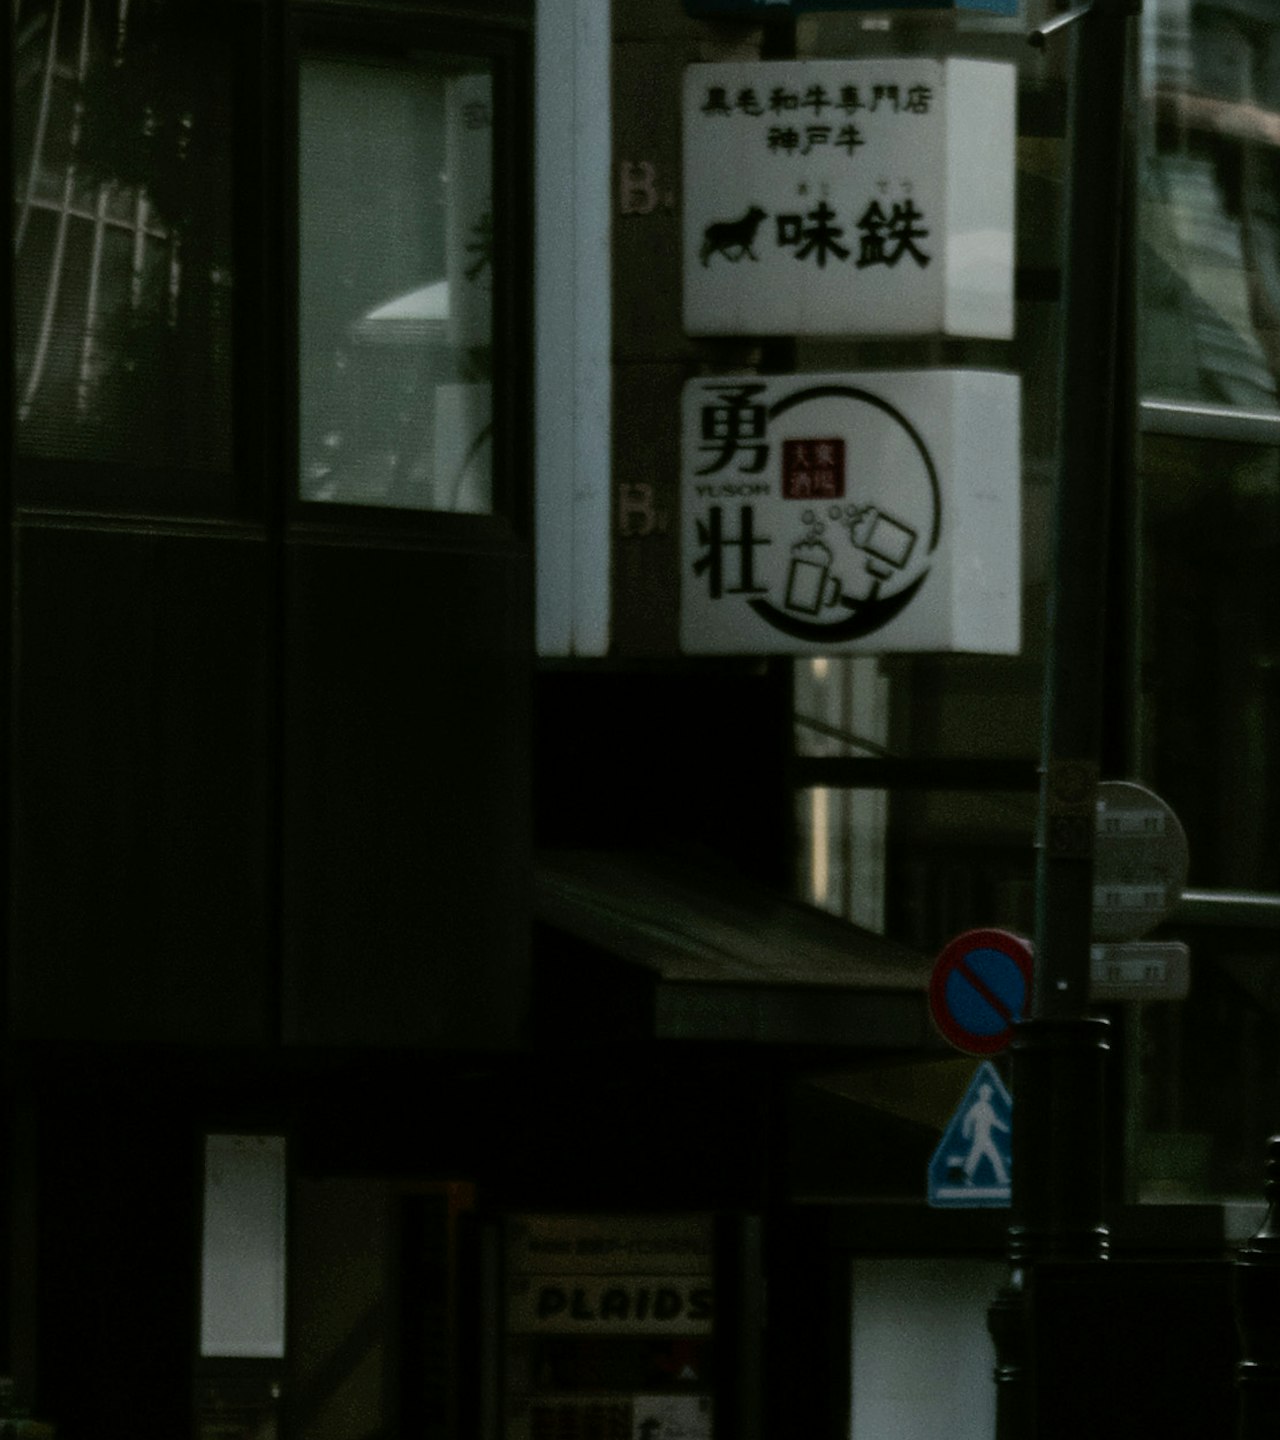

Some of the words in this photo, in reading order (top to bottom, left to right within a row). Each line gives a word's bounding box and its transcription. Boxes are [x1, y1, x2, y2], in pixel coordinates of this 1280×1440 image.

[767, 124, 866, 157] 神戸牛
[776, 199, 931, 270] 味鉄
[537, 1286, 713, 1322] PLAIDS
